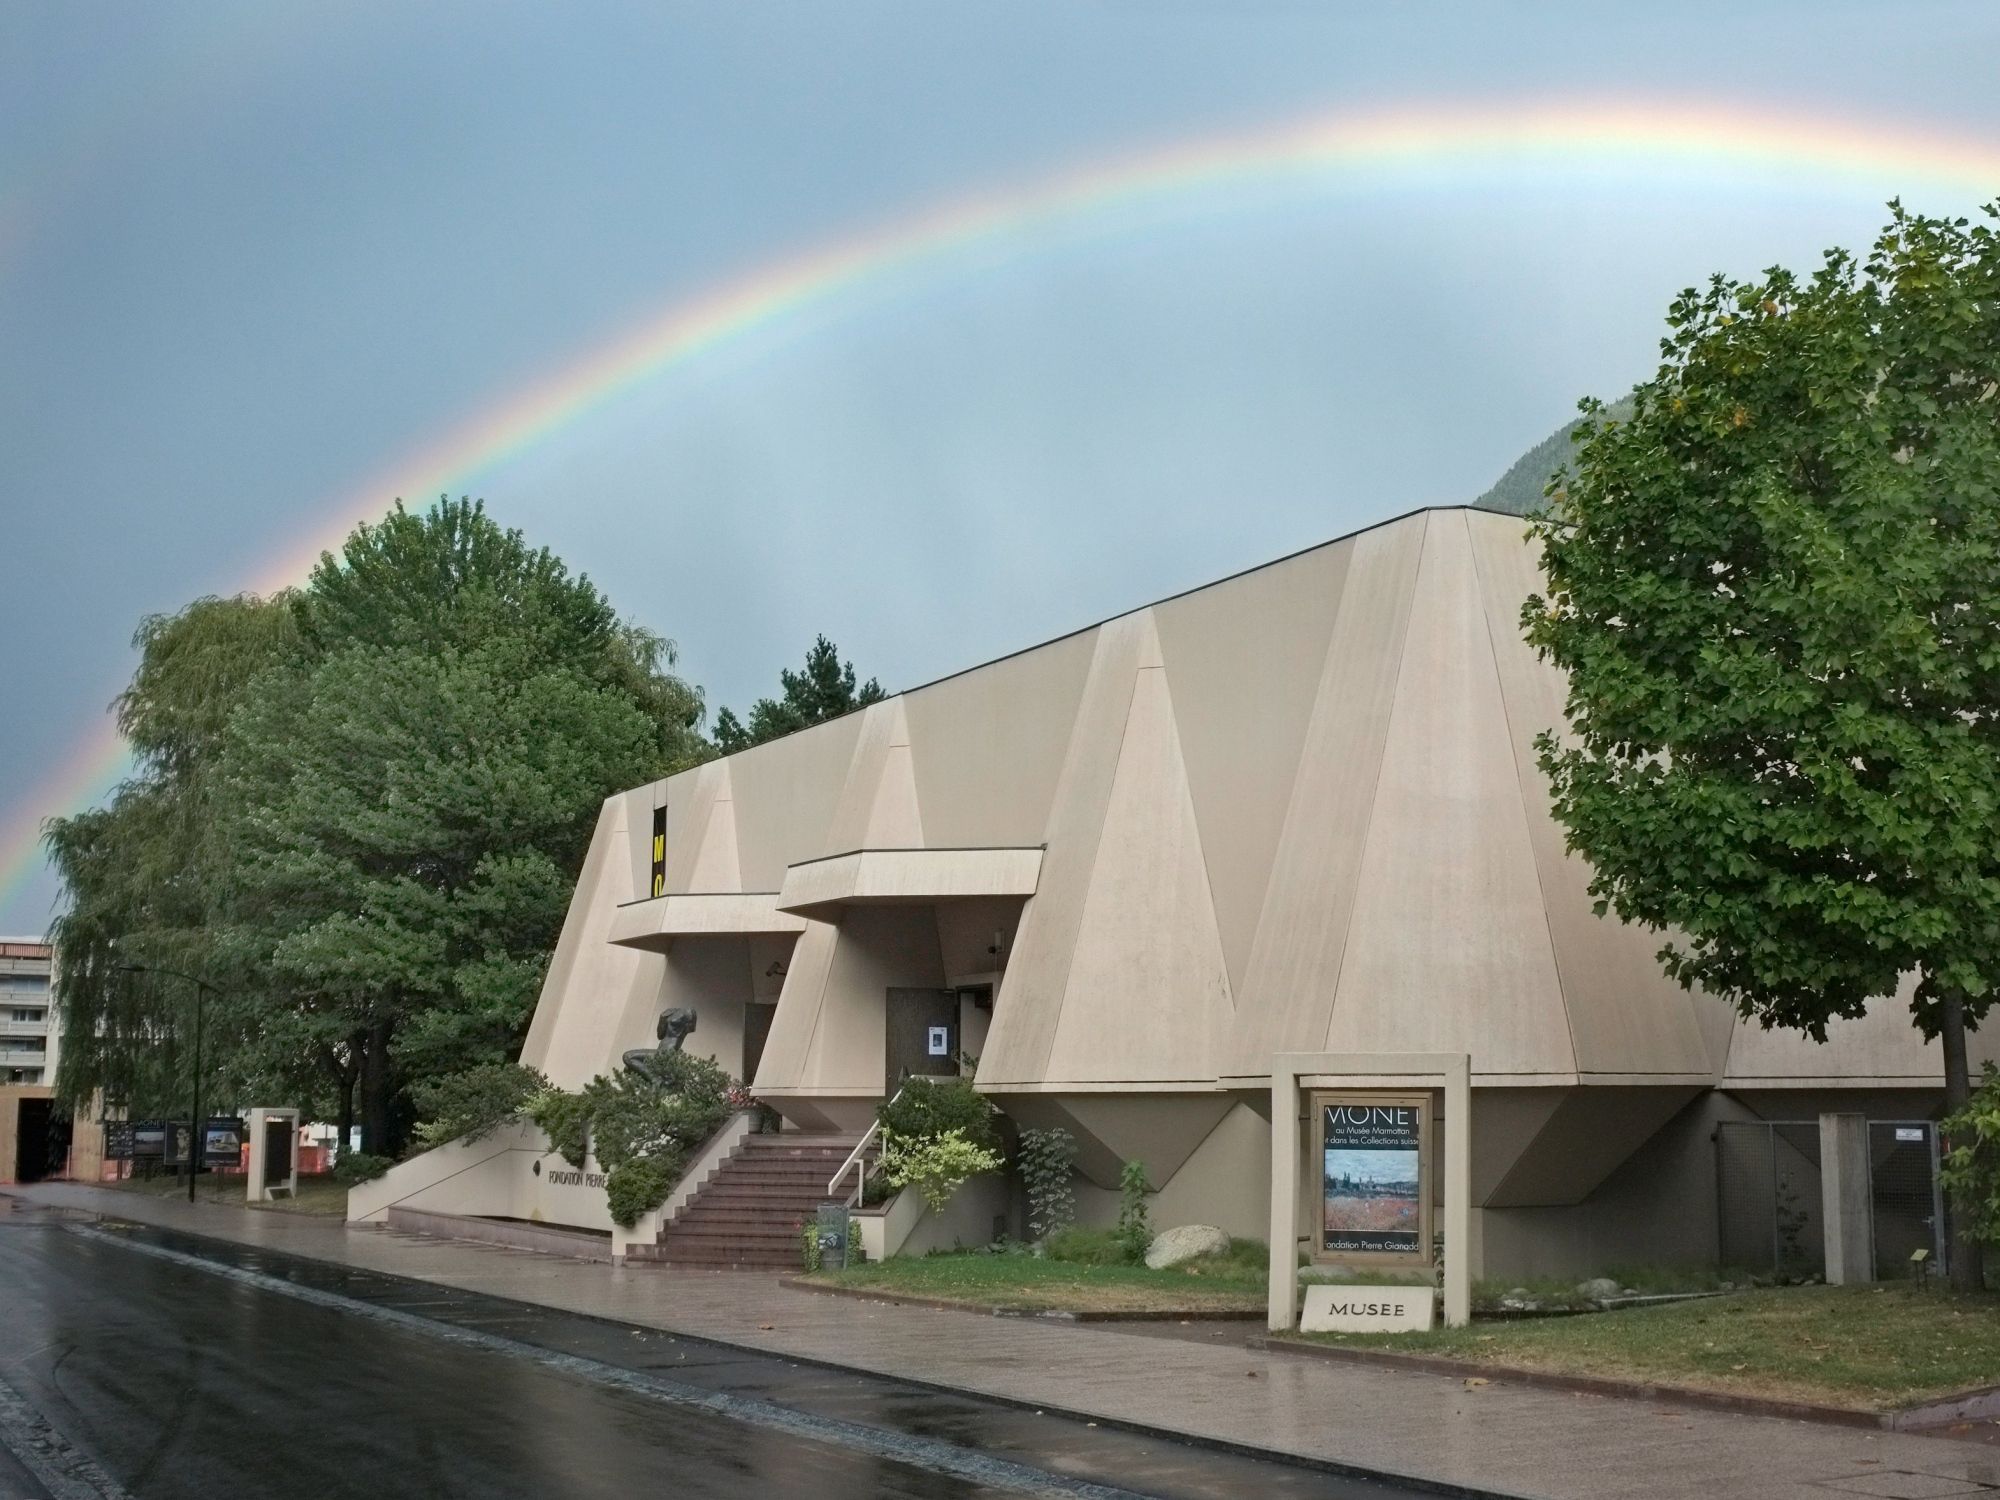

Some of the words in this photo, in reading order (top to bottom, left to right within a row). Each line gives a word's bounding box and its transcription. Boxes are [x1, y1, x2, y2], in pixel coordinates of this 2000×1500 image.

[1335, 1127, 1345, 1135] au
[1346, 1126, 1370, 1135] Musée
[1330, 1136, 1347, 1144] dans
[1349, 1136, 1359, 1144] les
[1360, 1136, 1399, 1145] Collections
[549, 1170, 583, 1187] FONDATION
[585, 1173, 606, 1188] PIERRE
[1326, 1239, 1360, 1249] ondation
[1361, 1240, 1383, 1250] Pierre
[1328, 1303, 1405, 1317] MUSEE
